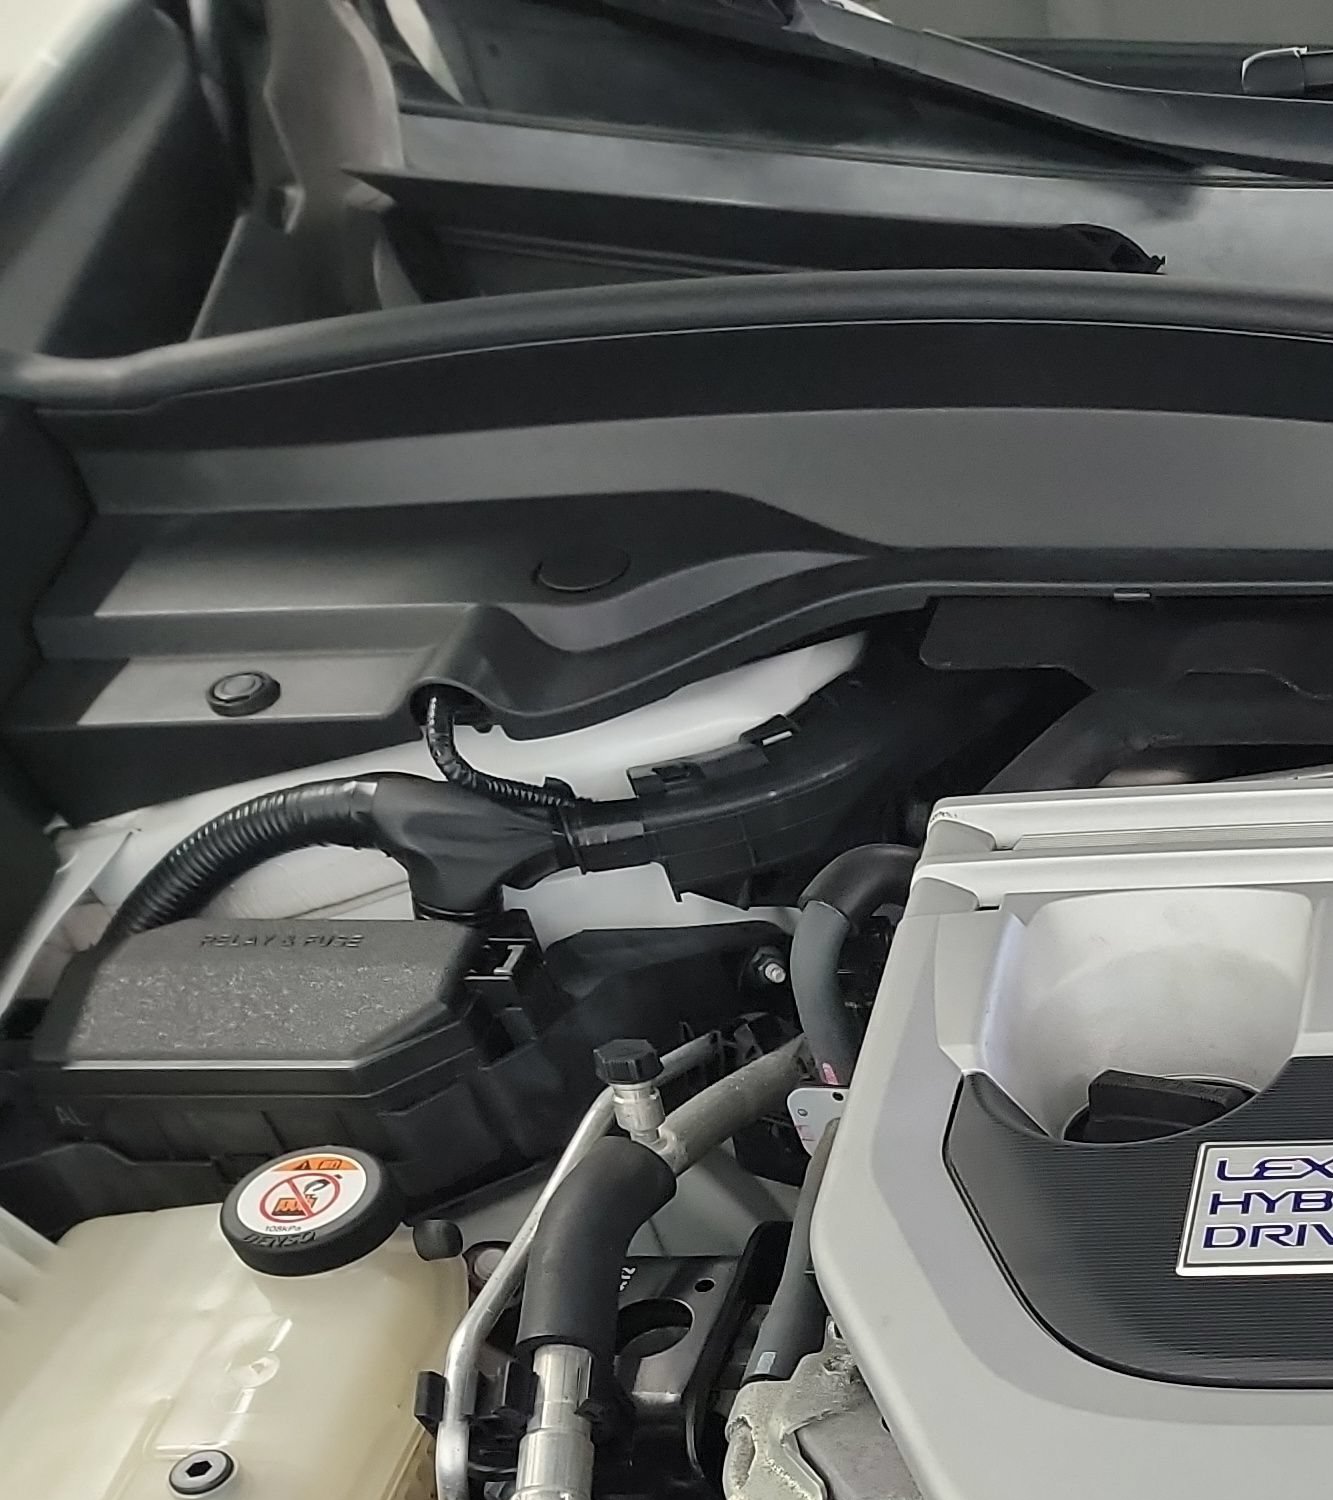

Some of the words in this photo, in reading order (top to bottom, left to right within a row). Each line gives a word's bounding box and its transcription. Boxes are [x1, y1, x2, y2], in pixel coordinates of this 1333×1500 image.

[201, 933, 276, 948] RELAY
[303, 933, 366, 948] FUSE
[243, 1230, 318, 1249] DENSO
